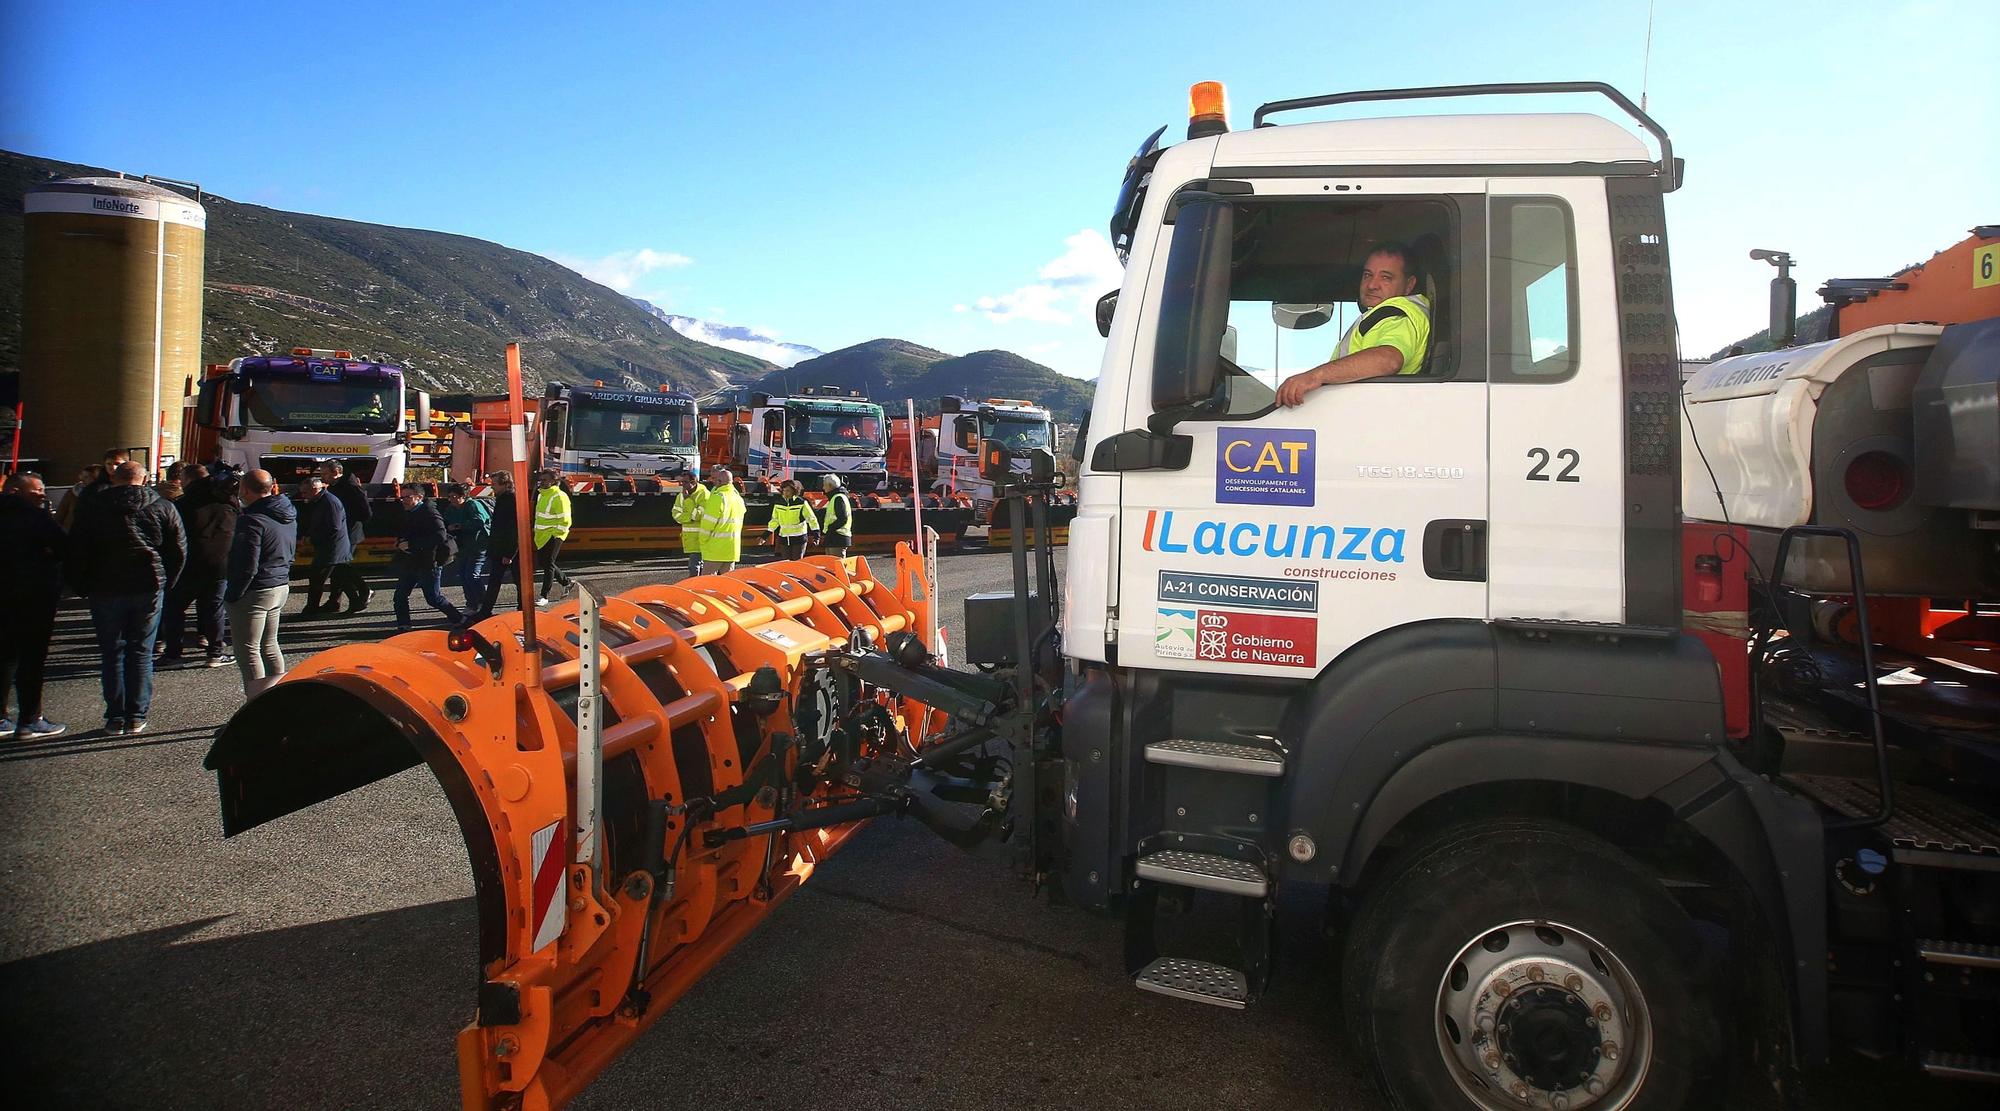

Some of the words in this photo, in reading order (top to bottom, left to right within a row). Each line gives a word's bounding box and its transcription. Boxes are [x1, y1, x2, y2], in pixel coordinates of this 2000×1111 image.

[93, 197, 141, 213] InfoNorte
[1981, 252, 1993, 280] 6
[313, 366, 339, 376] CAT
[590, 392, 625, 402] ARIDOS
[626, 394, 633, 402] Y
[634, 395, 663, 405] GRUAS
[664, 397, 686, 406] SANZ
[1224, 440, 1308, 474] CAT
[1356, 465, 1392, 479] TGS
[1396, 465, 1464, 480] 18.500
[1526, 447, 1580, 483] 22
[1225, 478, 1287, 486] DESENVOLUPAMENT
[1225, 485, 1268, 493] CONCESSIONS
[1283, 566, 1397, 581] construcciones
[1164, 580, 1193, 594] A-21
[1198, 583, 1313, 602] CONSERVACIÓN
[1231, 633, 1294, 649] Gobierno
[1231, 649, 1248, 659] de
[1252, 650, 1305, 664] Navarra
